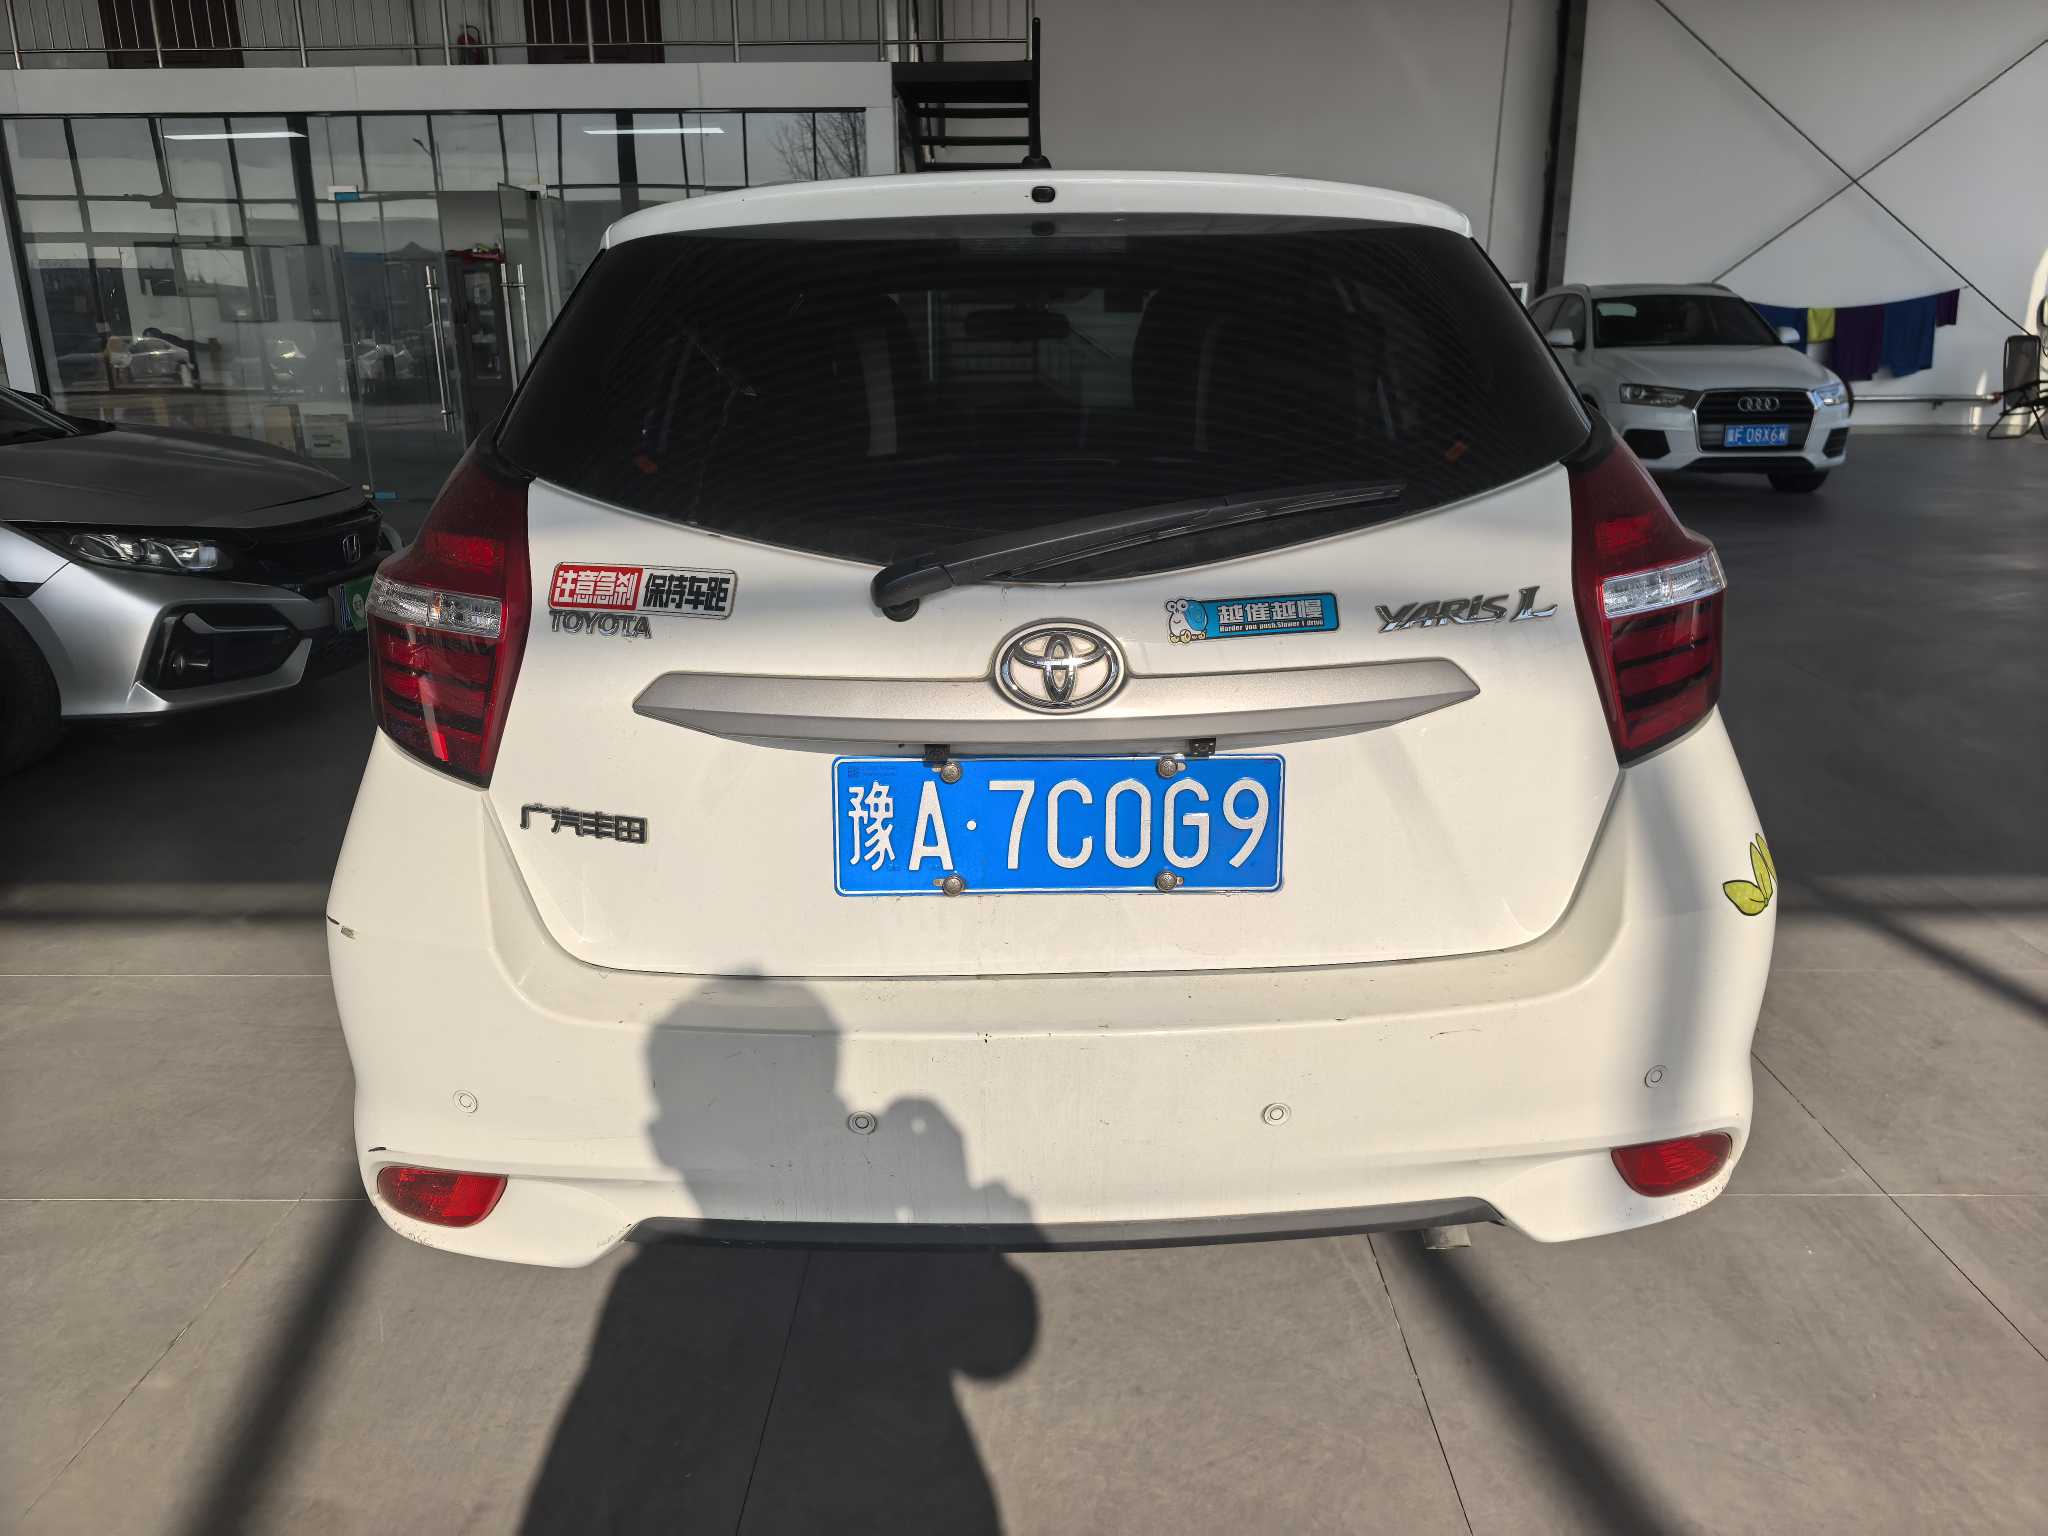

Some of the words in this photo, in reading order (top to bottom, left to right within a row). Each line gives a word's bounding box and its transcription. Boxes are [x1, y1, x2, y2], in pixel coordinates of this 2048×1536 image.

[552, 569, 638, 606] 注意急刹
[642, 573, 731, 612] 保持车距
[1374, 594, 1509, 633] YARIS
[1510, 585, 1558, 622] L
[550, 610, 653, 639] TOYOTA
[1217, 599, 1323, 624] 越催越慢
[519, 803, 648, 844] 广汽丰田
